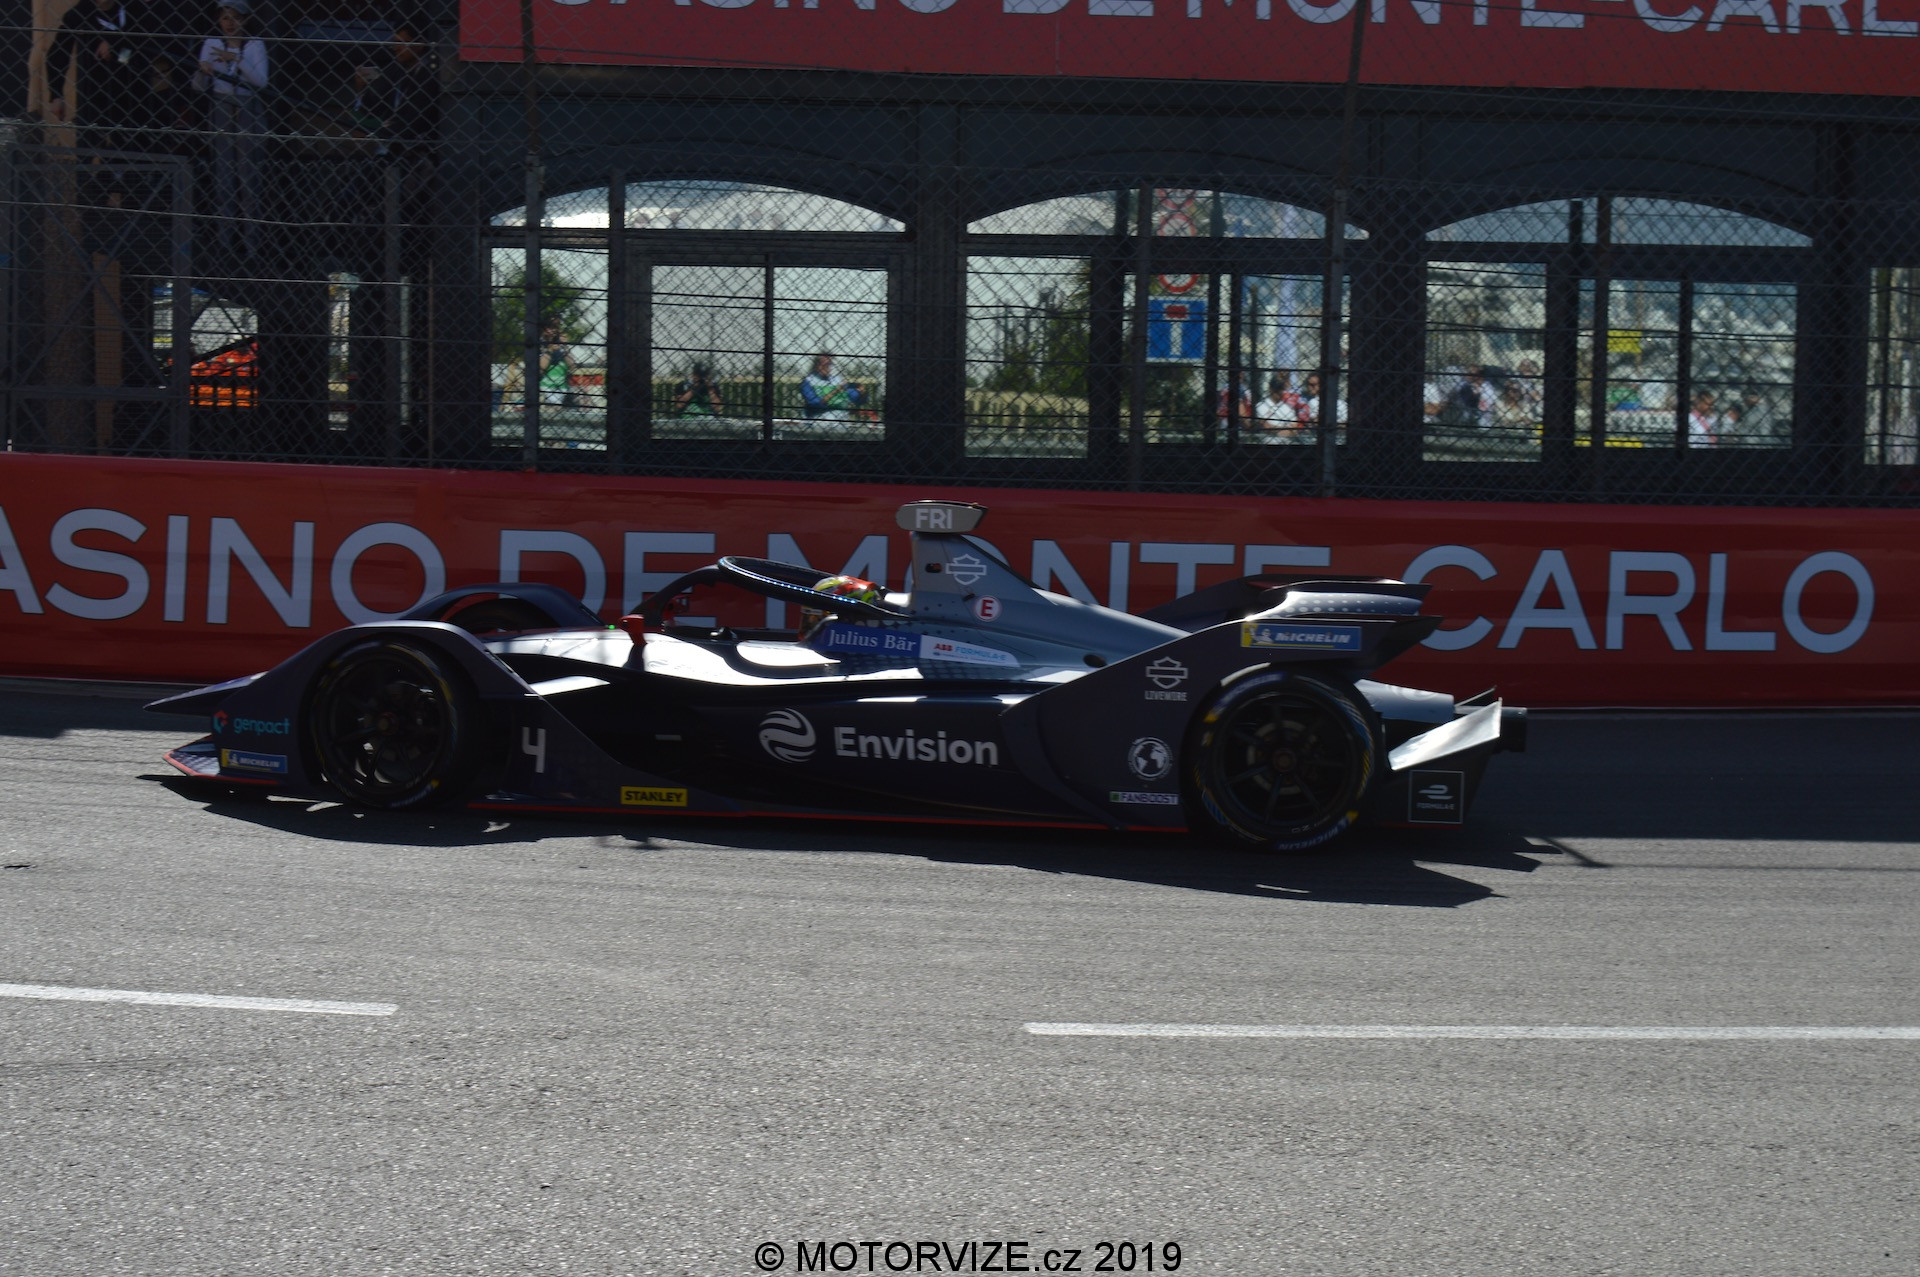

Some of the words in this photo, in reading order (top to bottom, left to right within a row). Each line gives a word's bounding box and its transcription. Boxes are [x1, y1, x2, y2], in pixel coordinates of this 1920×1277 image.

[915, 508, 953, 529] FRI
[1401, 544, 1875, 654] CARLO
[981, 600, 994, 617] E
[827, 630, 878, 648] Julius
[884, 635, 917, 652] Bär
[1275, 632, 1352, 644] MICHELIN
[934, 643, 954, 652] ABB
[233, 716, 290, 736] genpact
[522, 726, 547, 774] 4
[833, 726, 1000, 767] Envision
[239, 757, 280, 768] MICHELIN
[625, 791, 683, 803] STANLEY
[1121, 793, 1178, 805] FANBOOST
